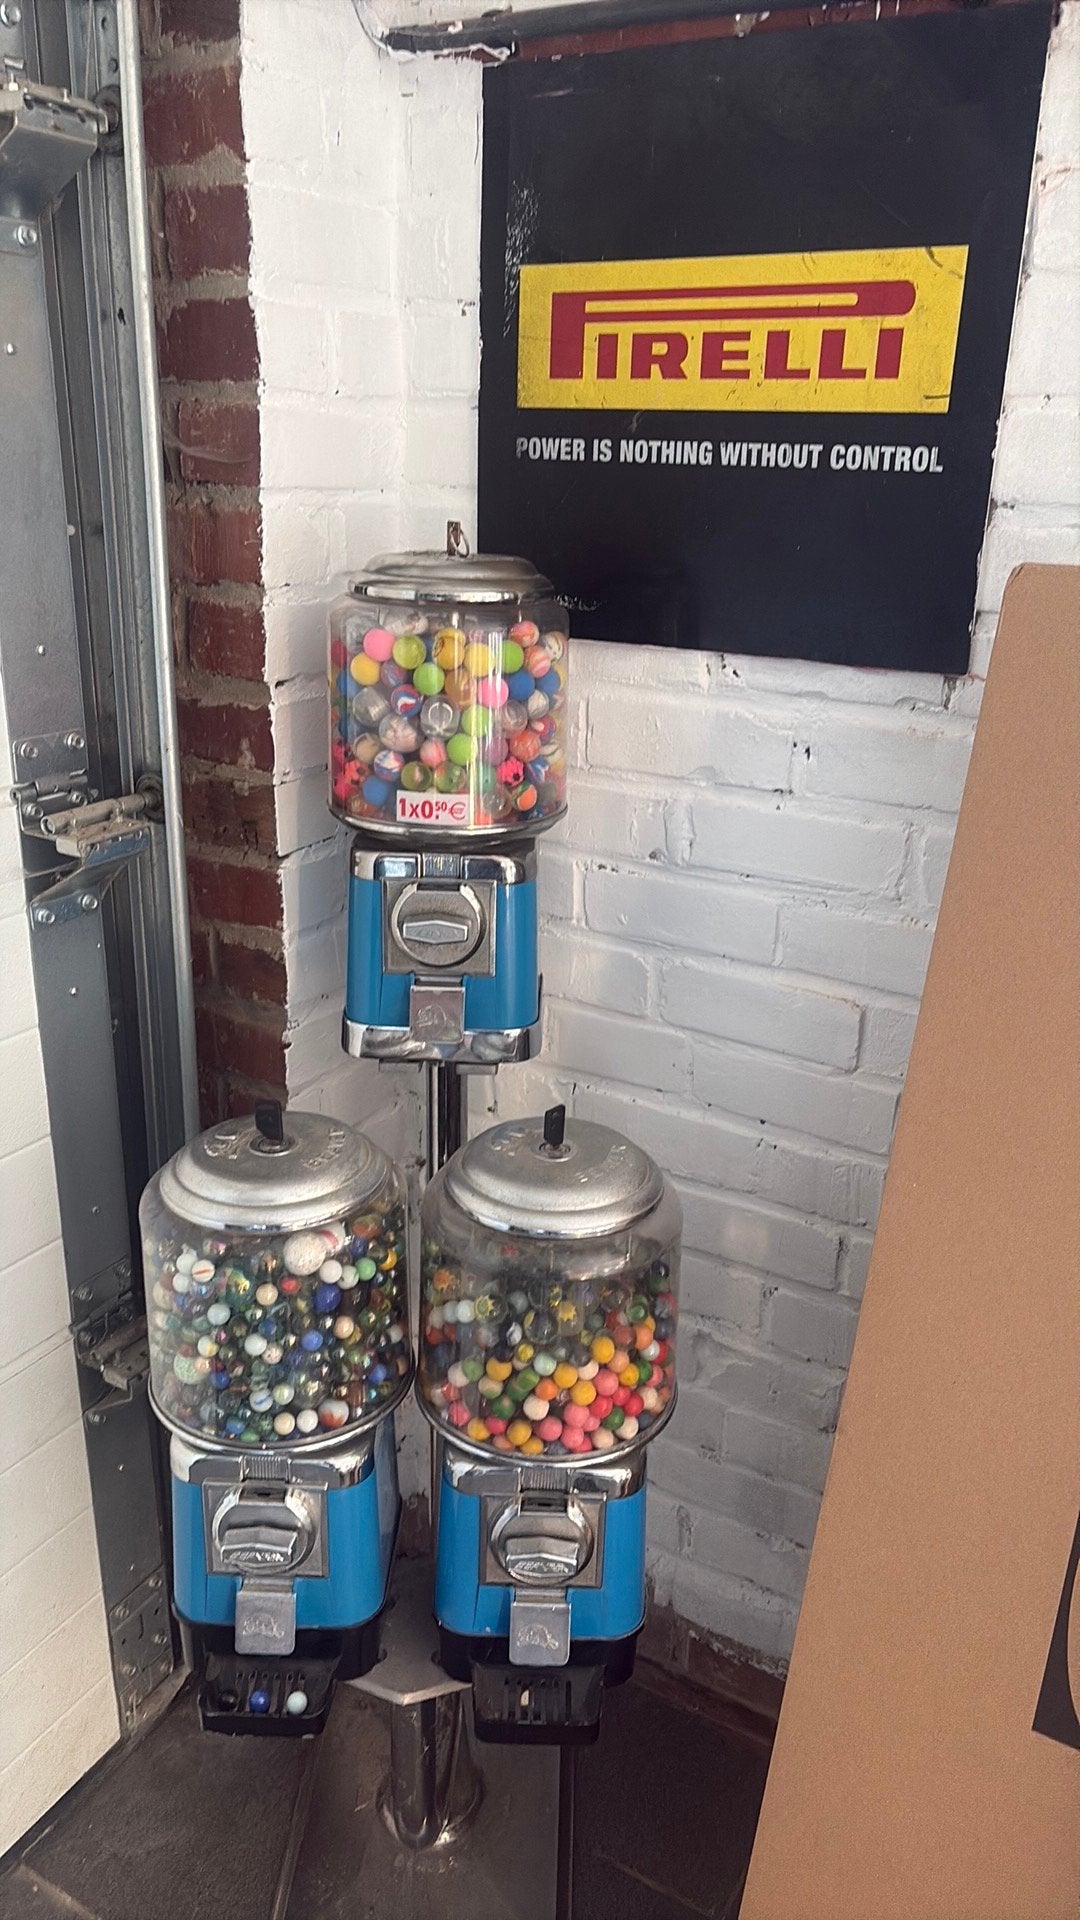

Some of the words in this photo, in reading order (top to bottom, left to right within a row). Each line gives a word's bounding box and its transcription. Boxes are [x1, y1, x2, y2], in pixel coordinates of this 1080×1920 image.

[549, 280, 917, 379] PIRELLI
[516, 437, 585, 461] POWER
[593, 438, 612, 462] IS
[619, 439, 713, 466] NOTHING
[720, 442, 823, 469] WITHOUT
[830, 444, 943, 473] CONTROL
